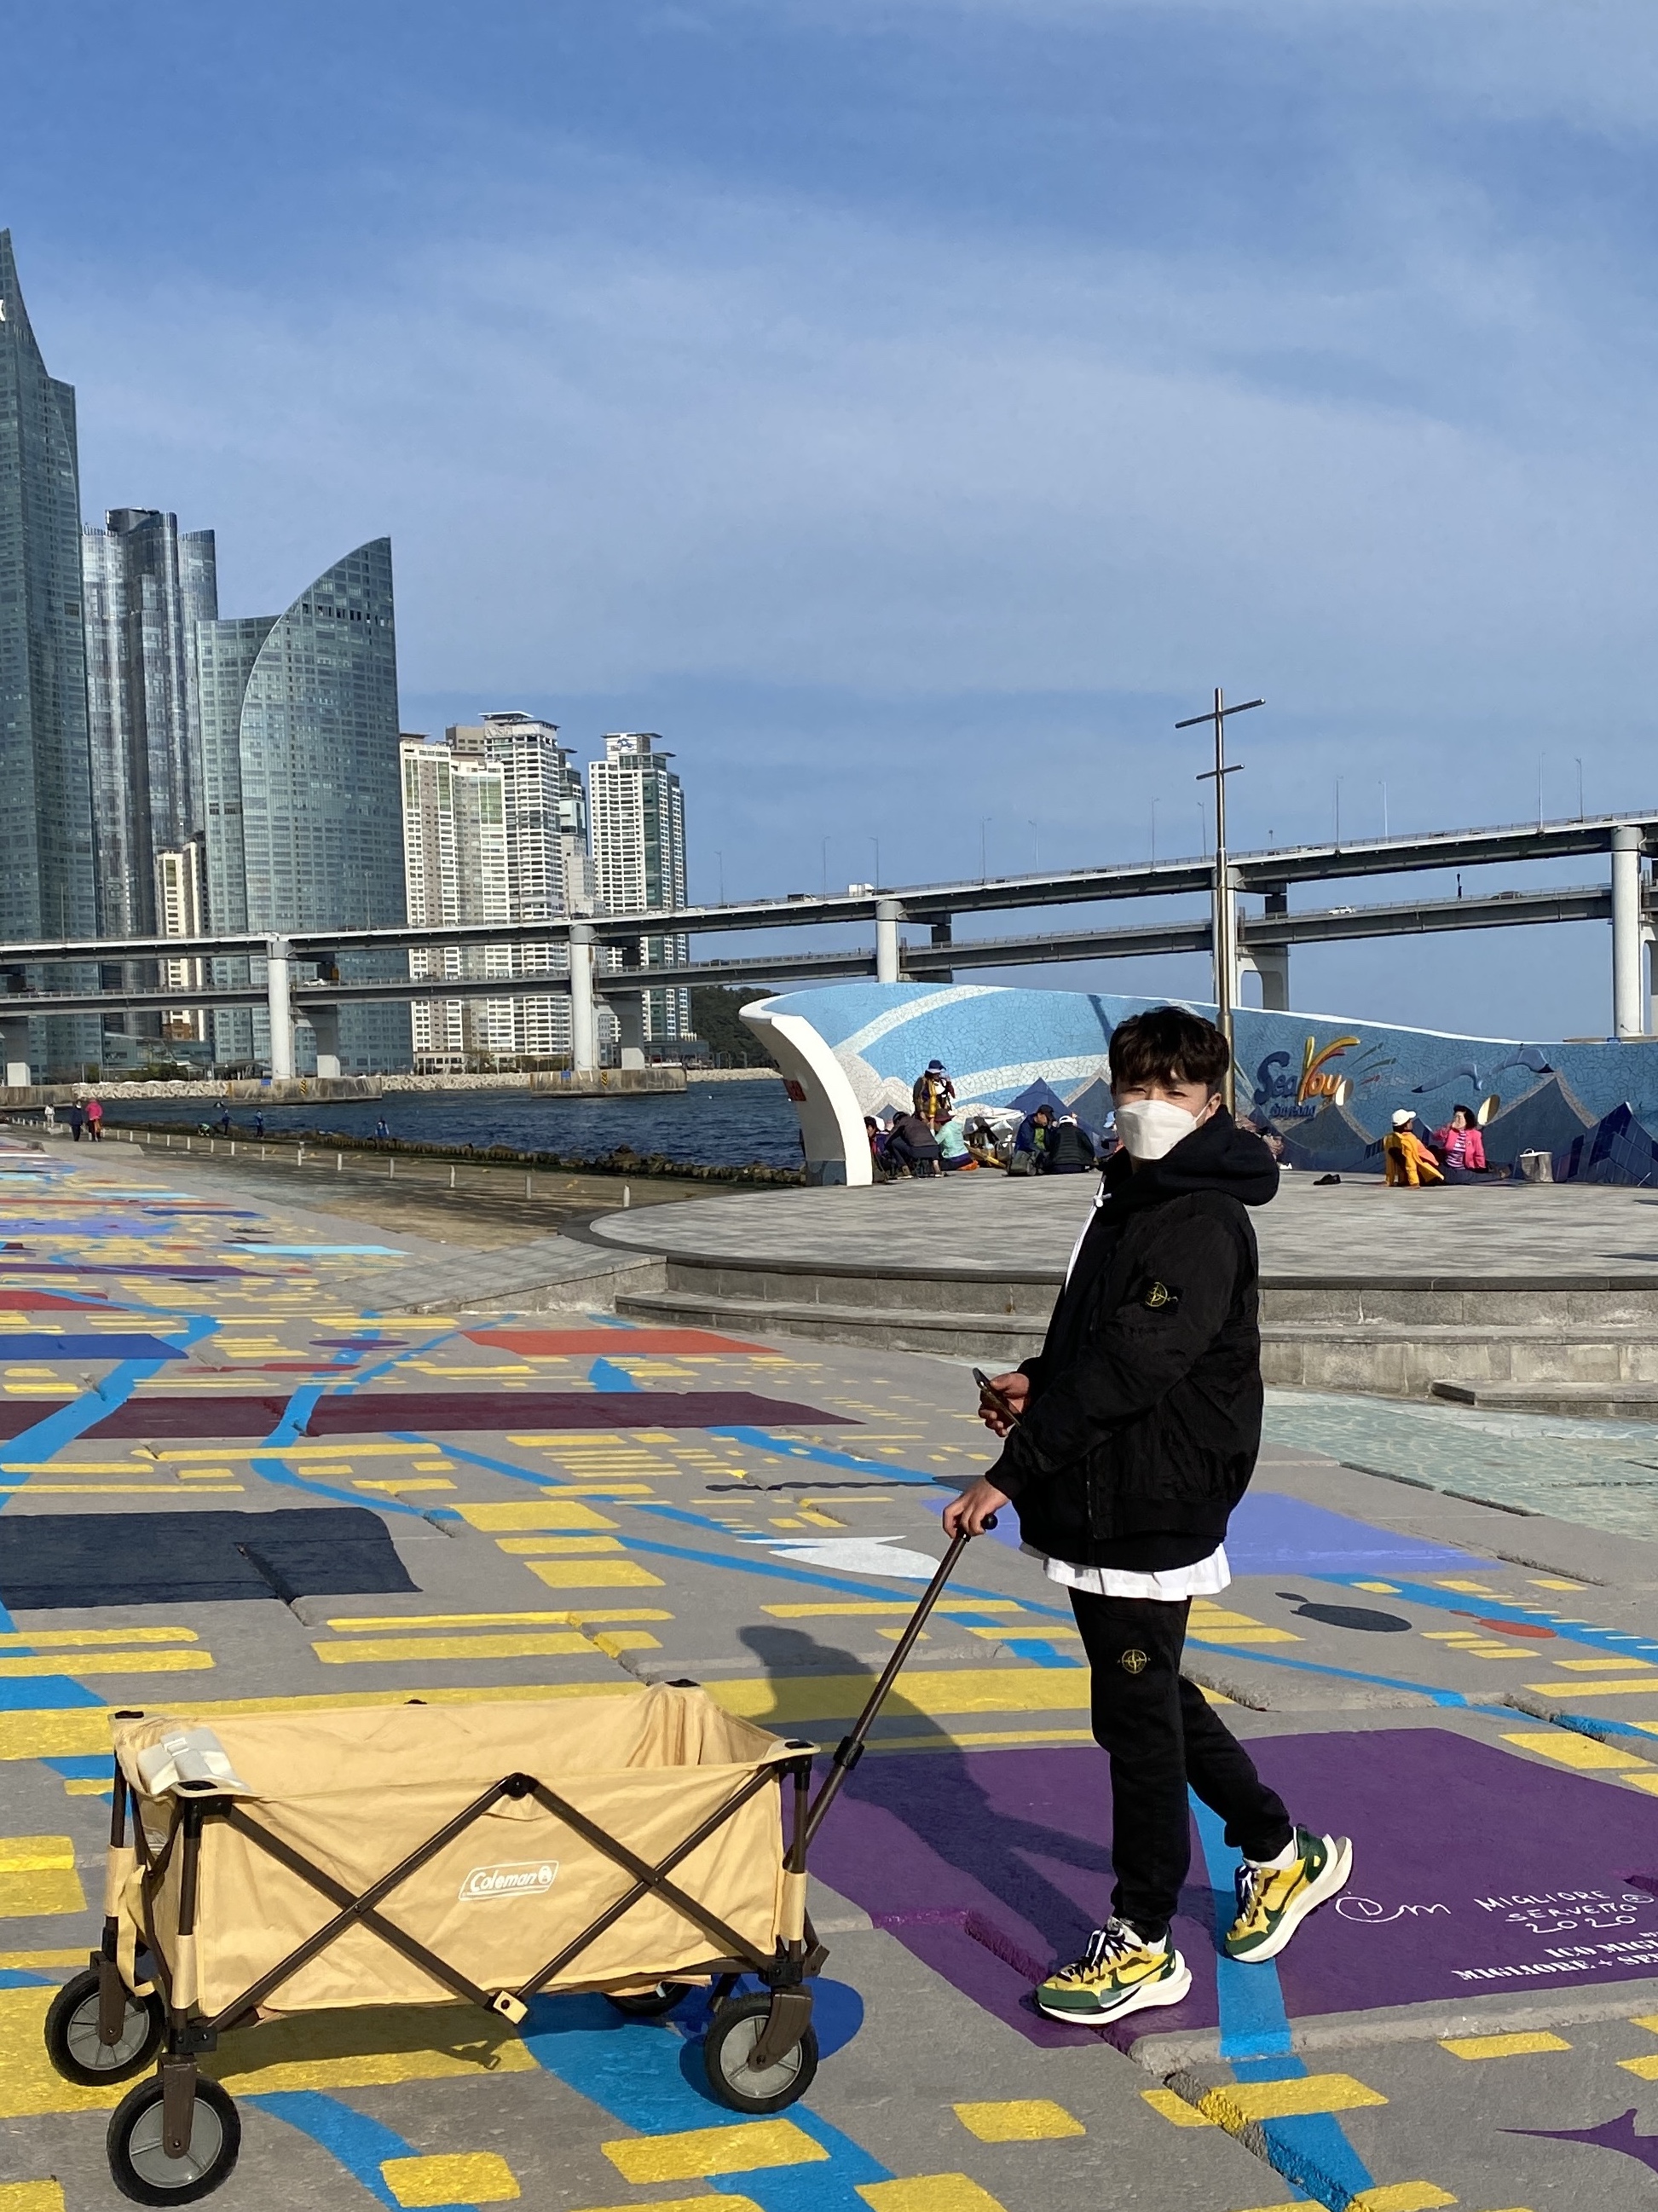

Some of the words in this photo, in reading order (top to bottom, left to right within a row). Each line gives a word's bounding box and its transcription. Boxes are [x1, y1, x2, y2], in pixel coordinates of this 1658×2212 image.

[1254, 1051, 1297, 1106] Sea
[1297, 1036, 1361, 1106] You
[470, 1869, 538, 1892] Coleman
[1473, 1890, 1611, 1912] MIGLIORE
[1505, 1902, 1638, 1922] SERVETTO
[1524, 1915, 1637, 1934] 2020
[1543, 1945, 1597, 1958] ICO
